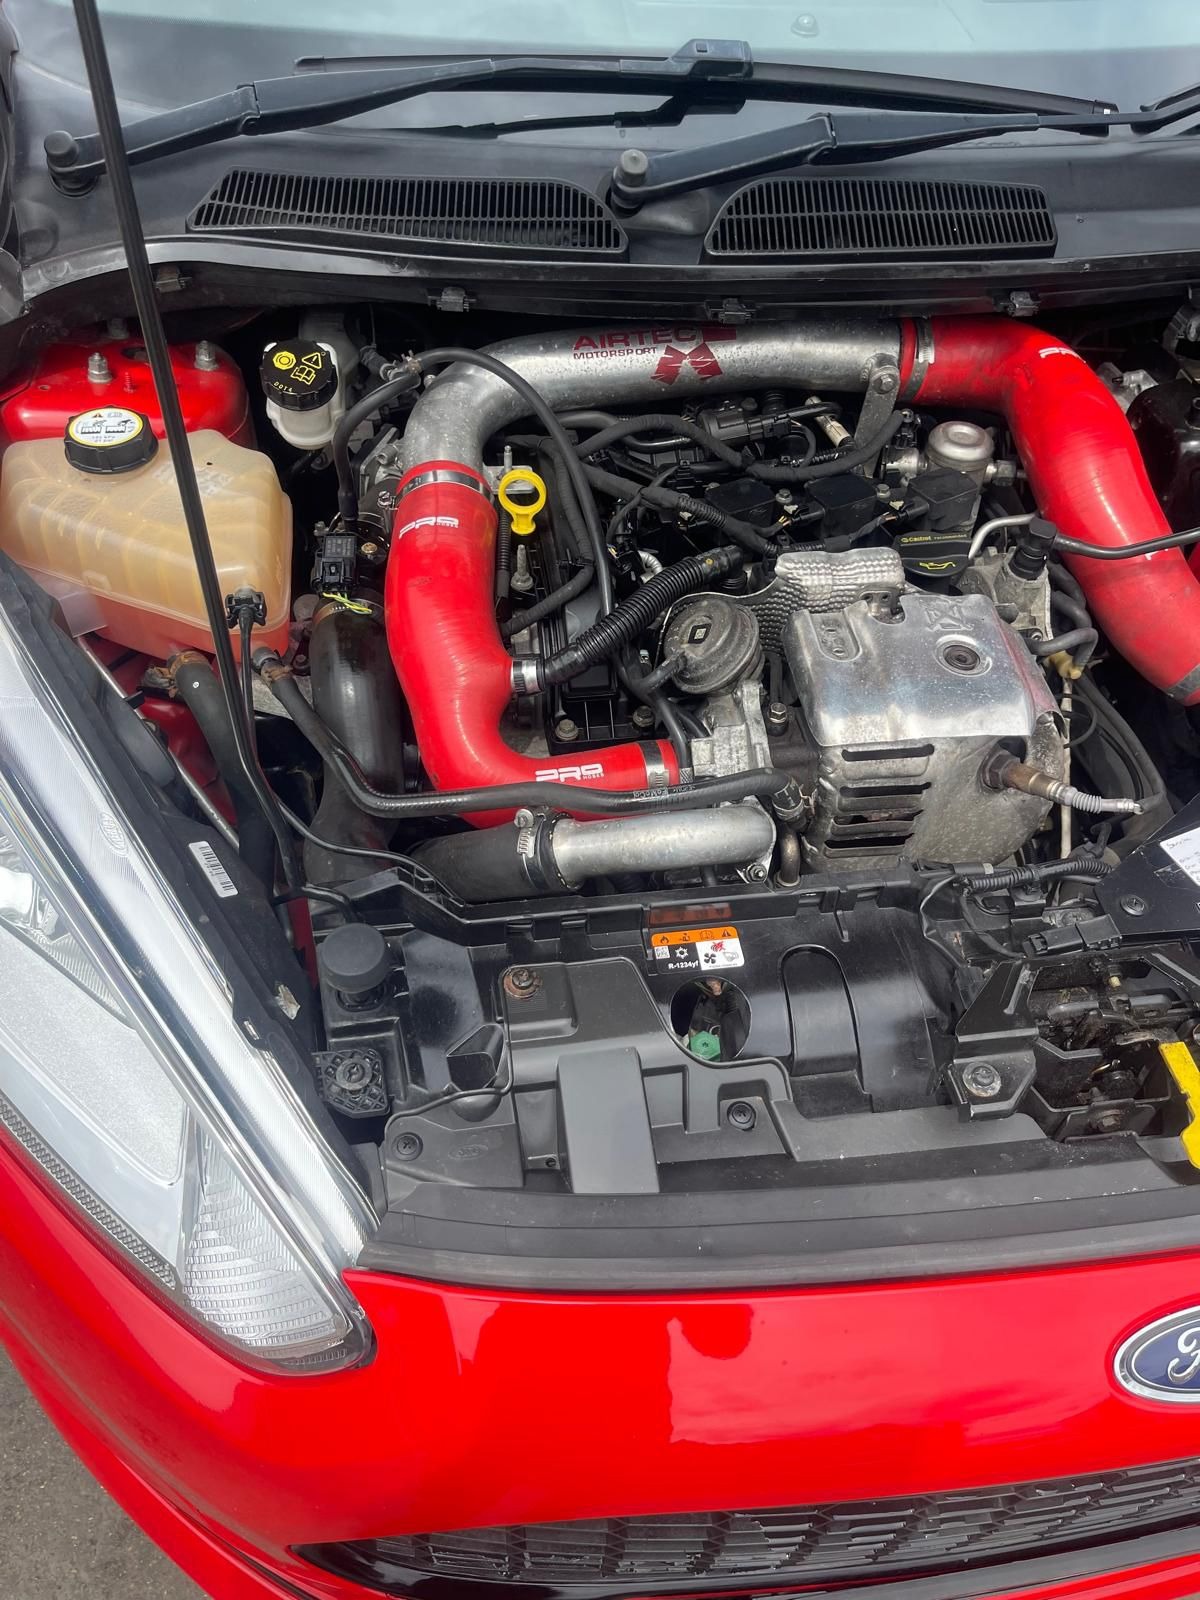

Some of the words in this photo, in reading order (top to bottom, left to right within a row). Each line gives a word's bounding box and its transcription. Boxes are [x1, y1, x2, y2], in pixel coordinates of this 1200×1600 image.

[574, 326, 696, 350] AIRTEC
[573, 346, 656, 360] MOTORSPORT
[535, 763, 603, 782] PRO
[667, 960, 699, 970] R-1234yf
